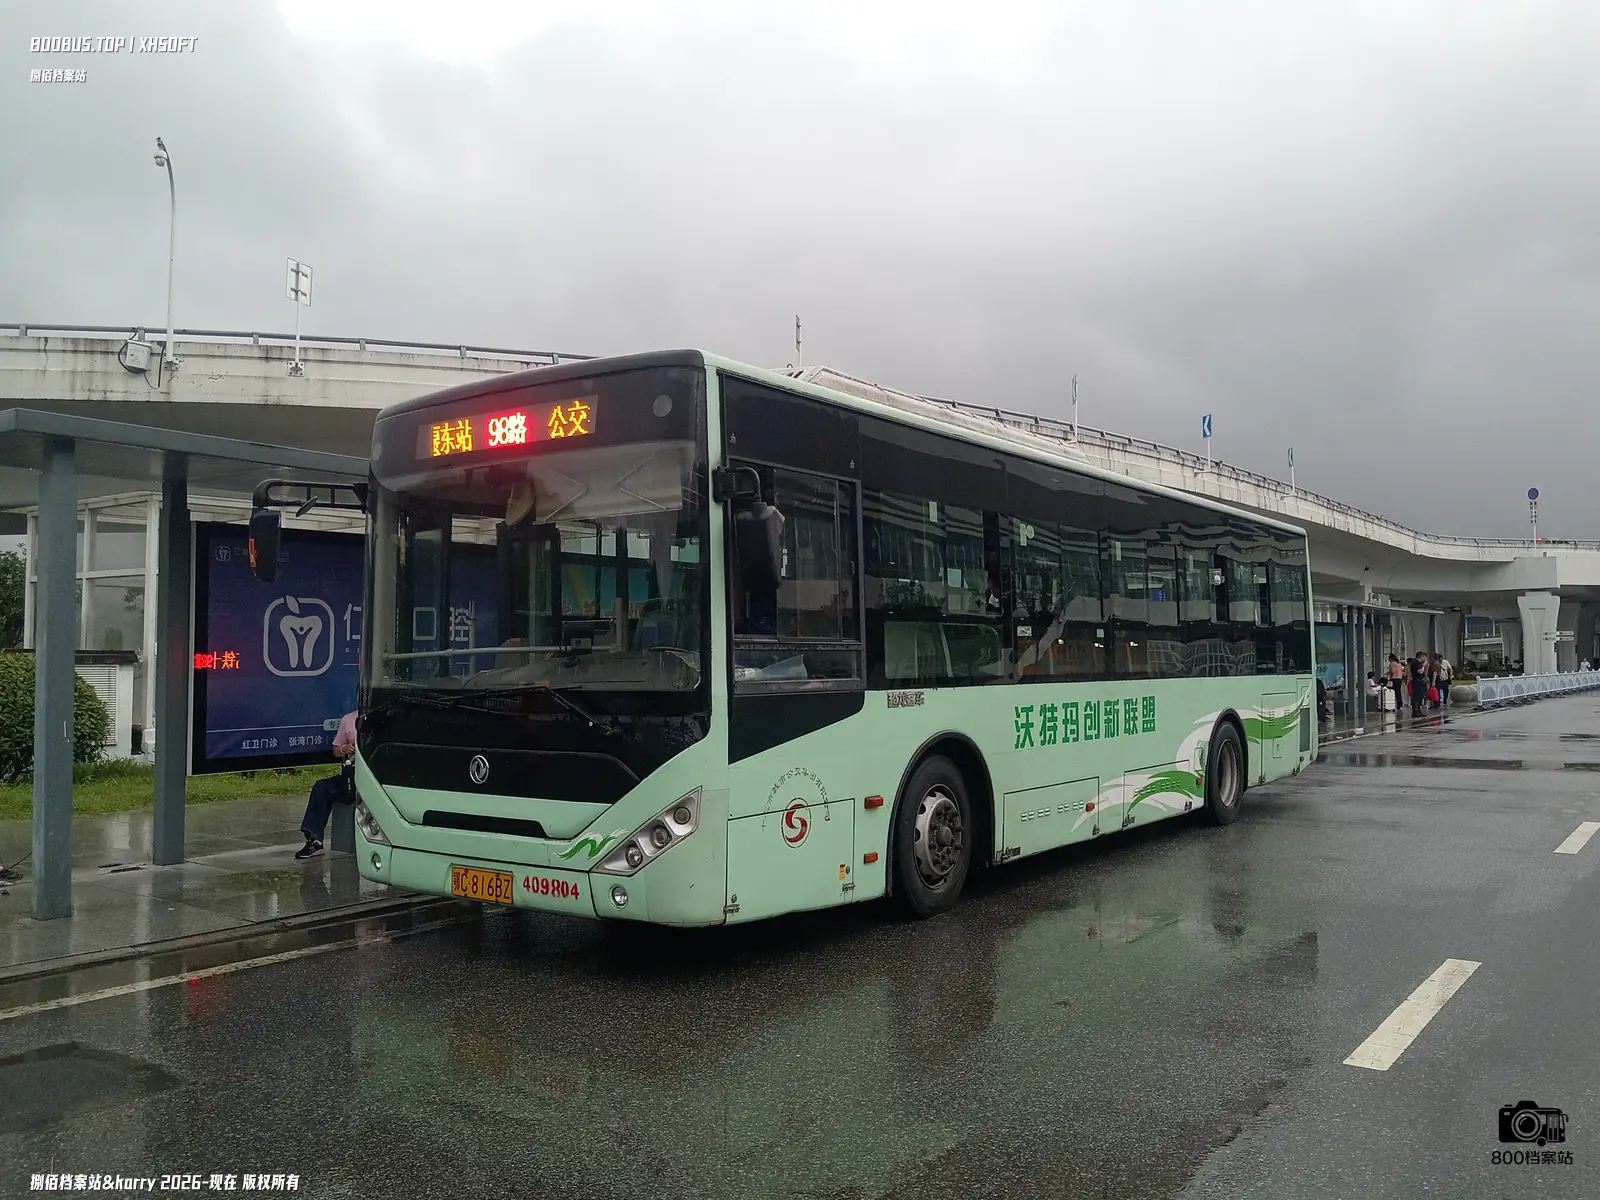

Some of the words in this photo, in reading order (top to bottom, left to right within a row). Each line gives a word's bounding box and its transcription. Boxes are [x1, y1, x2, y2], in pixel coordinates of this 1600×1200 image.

[488, 412, 528, 447] 98路
[547, 399, 591, 439] 公交
[1014, 695, 1156, 749] 沃特玛创新联盟
[241, 737, 278, 750] 红卫门诊
[288, 735, 323, 747] 张湾门诊
[523, 875, 580, 900] 409804
